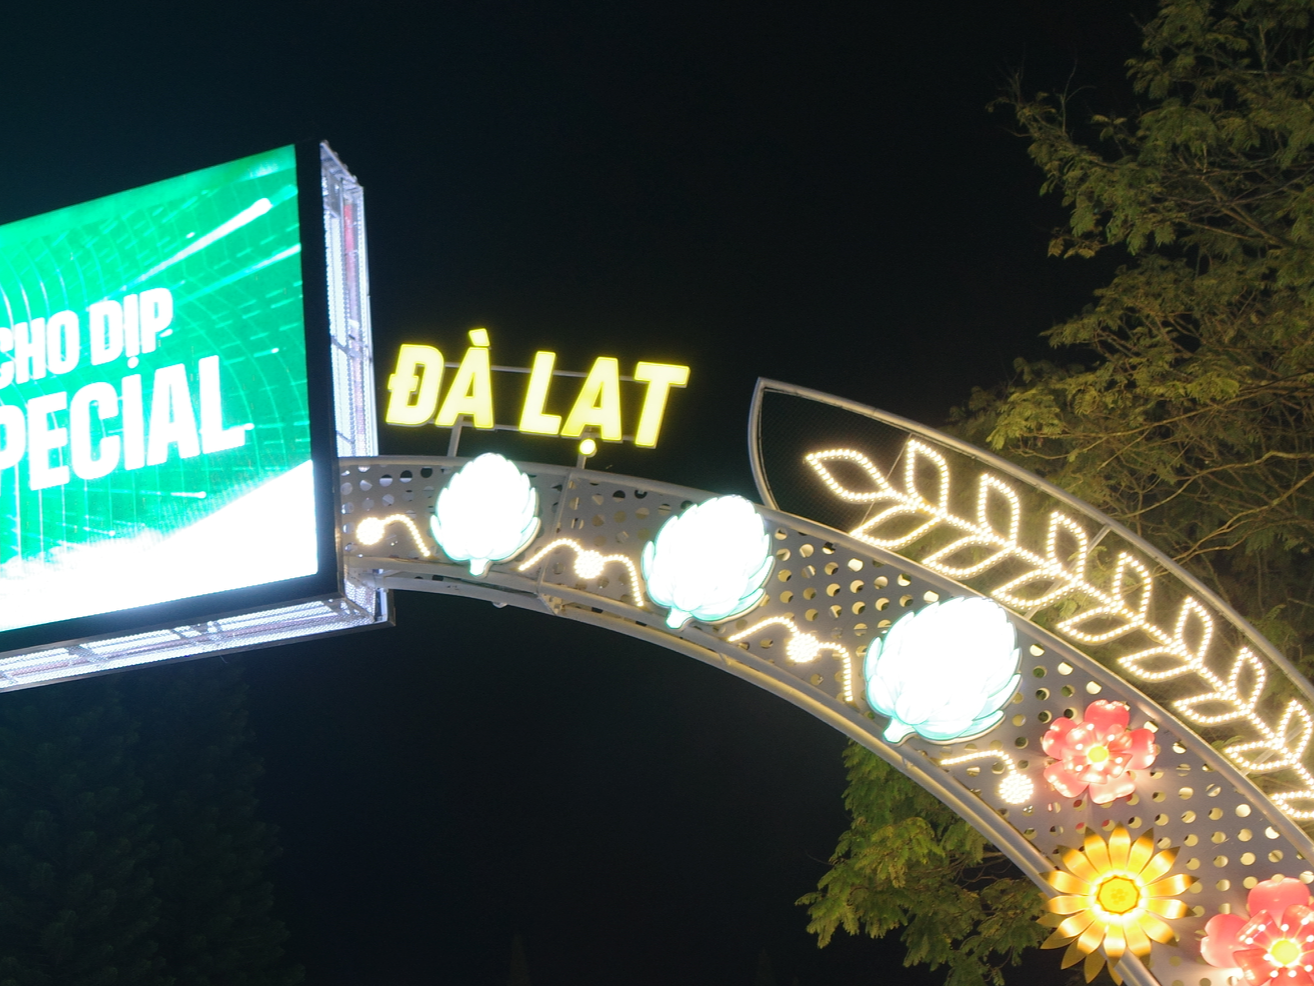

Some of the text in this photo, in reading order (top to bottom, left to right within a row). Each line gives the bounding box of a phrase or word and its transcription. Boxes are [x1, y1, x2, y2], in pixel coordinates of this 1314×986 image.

[89, 287, 174, 369] DỊP
[385, 328, 691, 456] ĐÀ LẠT
